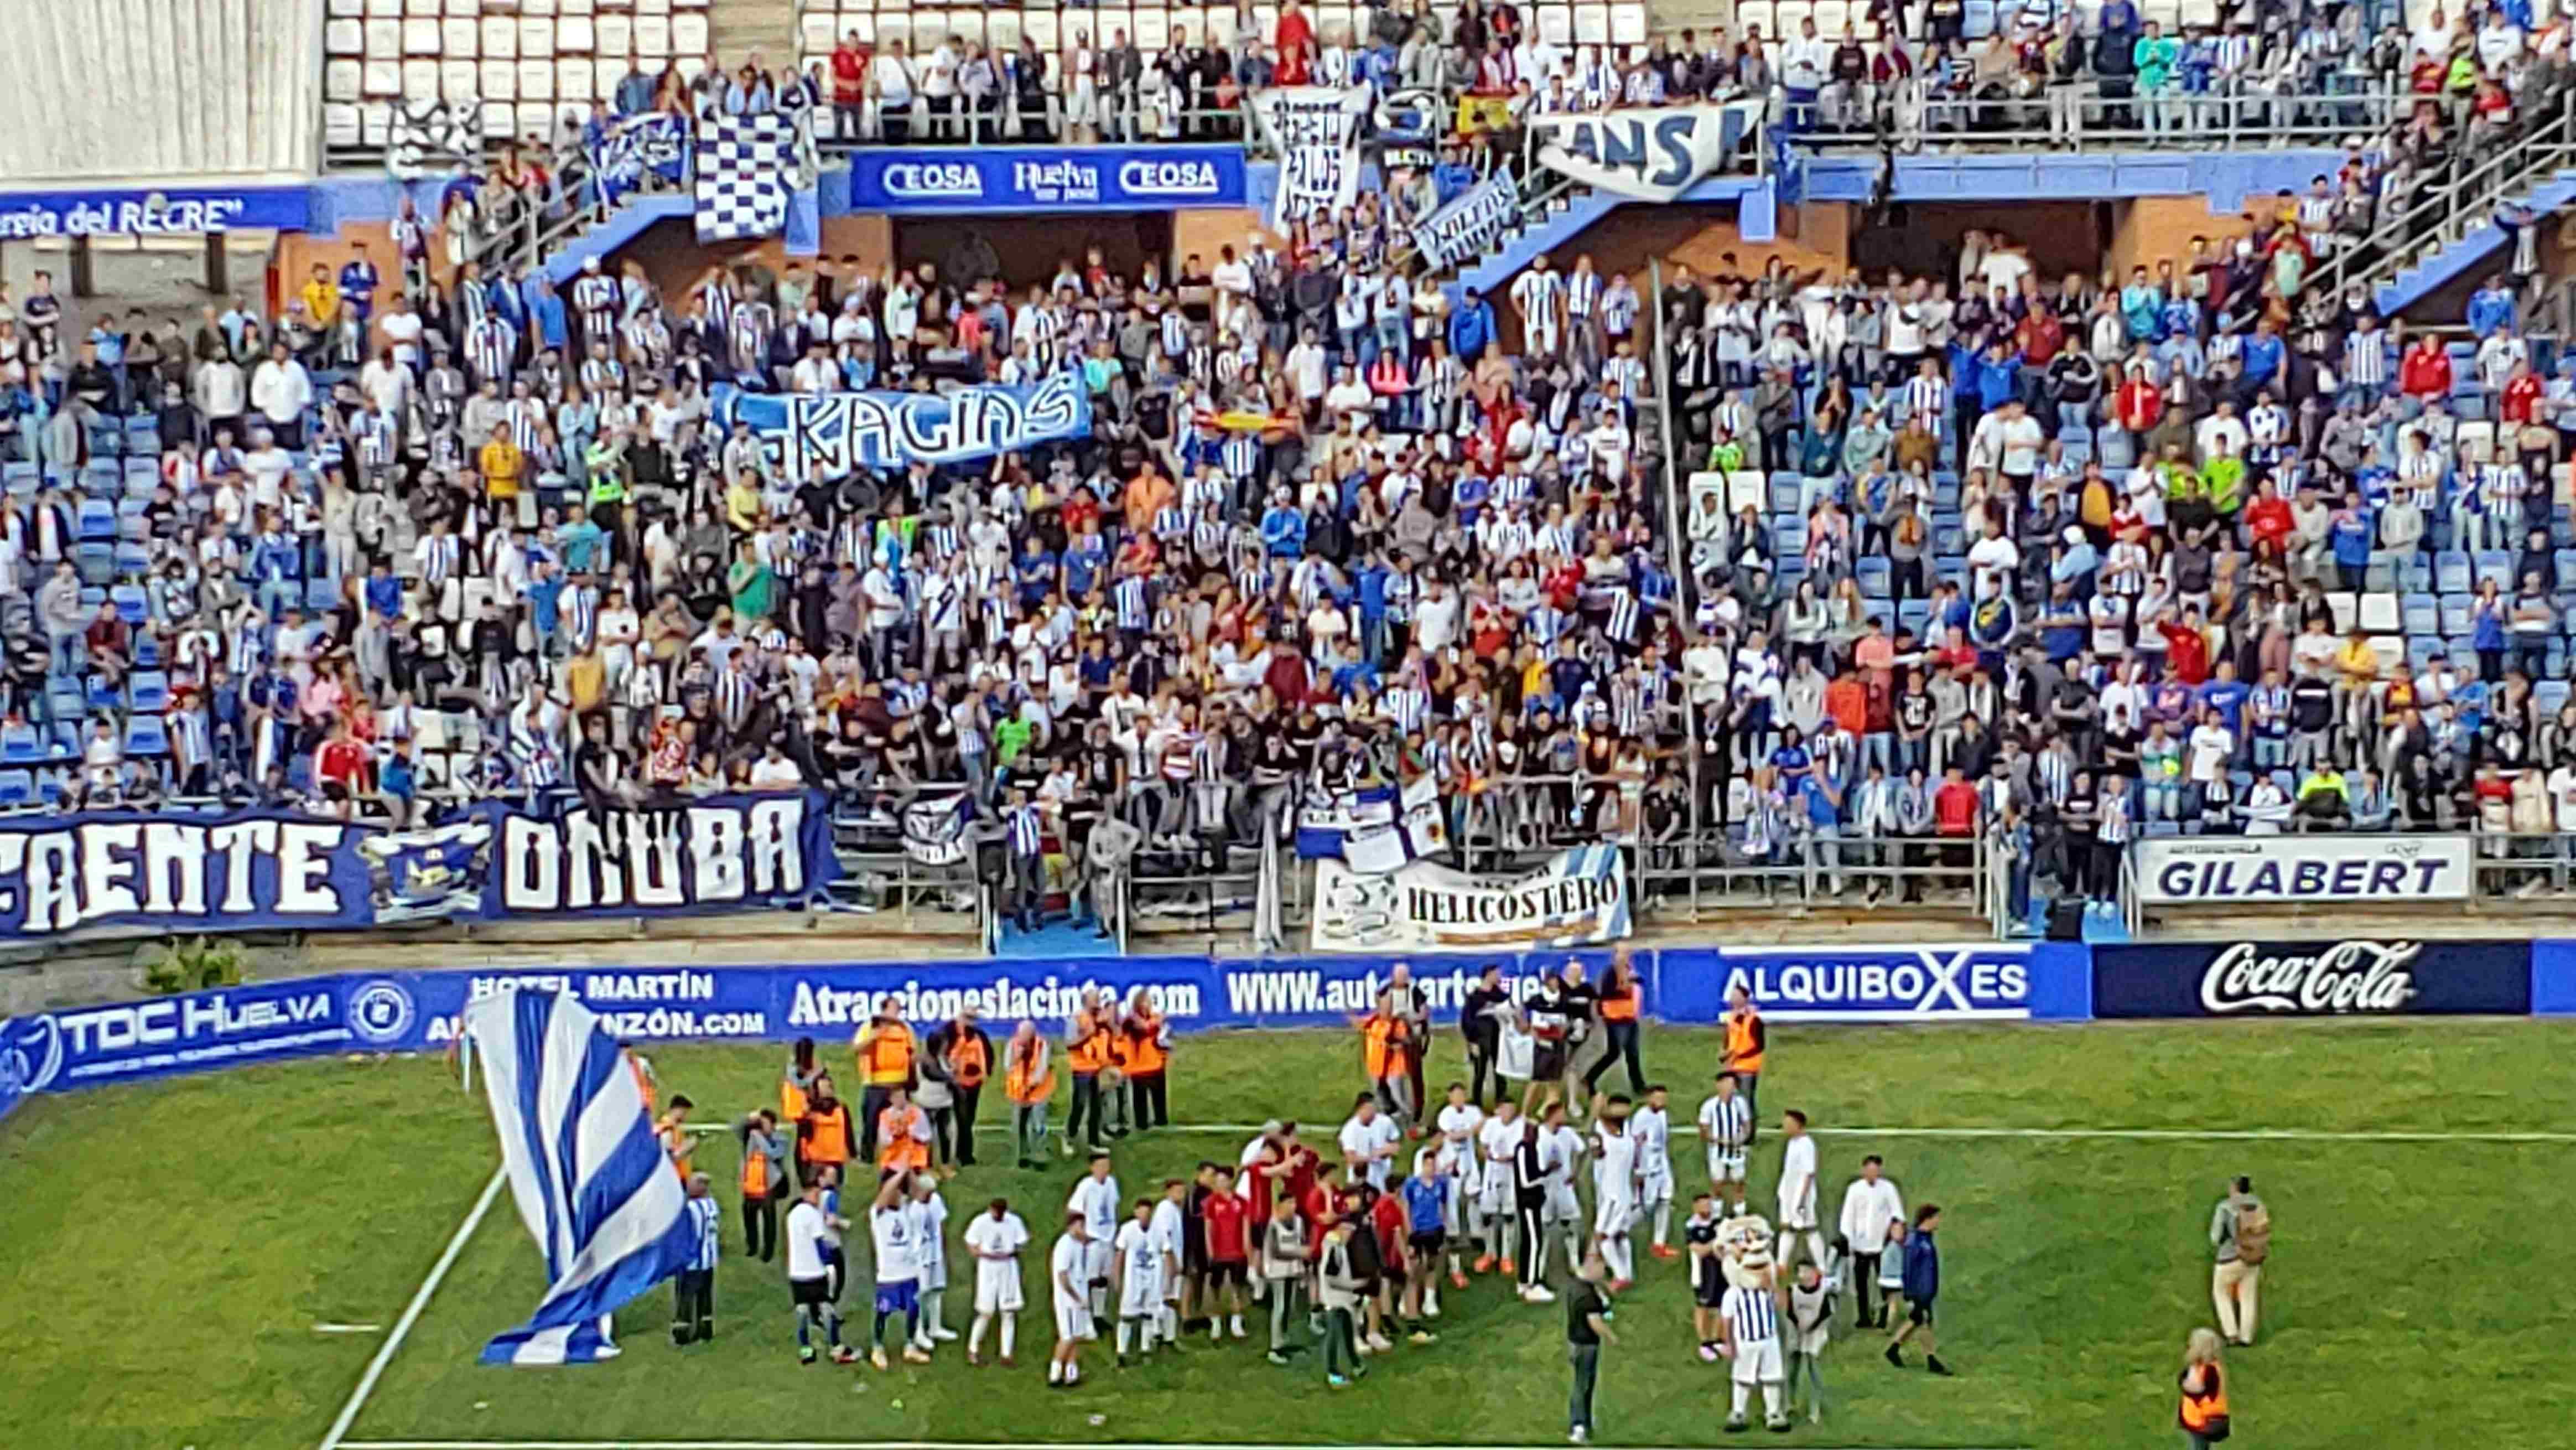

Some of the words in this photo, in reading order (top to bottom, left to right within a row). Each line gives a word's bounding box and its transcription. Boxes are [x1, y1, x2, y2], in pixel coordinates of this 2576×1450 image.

[884, 164, 982, 196] CEOSA
[1119, 162, 1218, 194] CEOSA
[65, 200, 112, 235] del
[504, 798, 804, 910] ONUBA
[1407, 872, 1618, 924] HELICOSTERO
[2159, 858, 2448, 897] GILABERT
[586, 970, 714, 1000] MARTÍN
[1723, 949, 2027, 1012] ALQUIBOXES
[2201, 940, 2423, 1013] Coca-Cola
[60, 1000, 178, 1054] TOC
